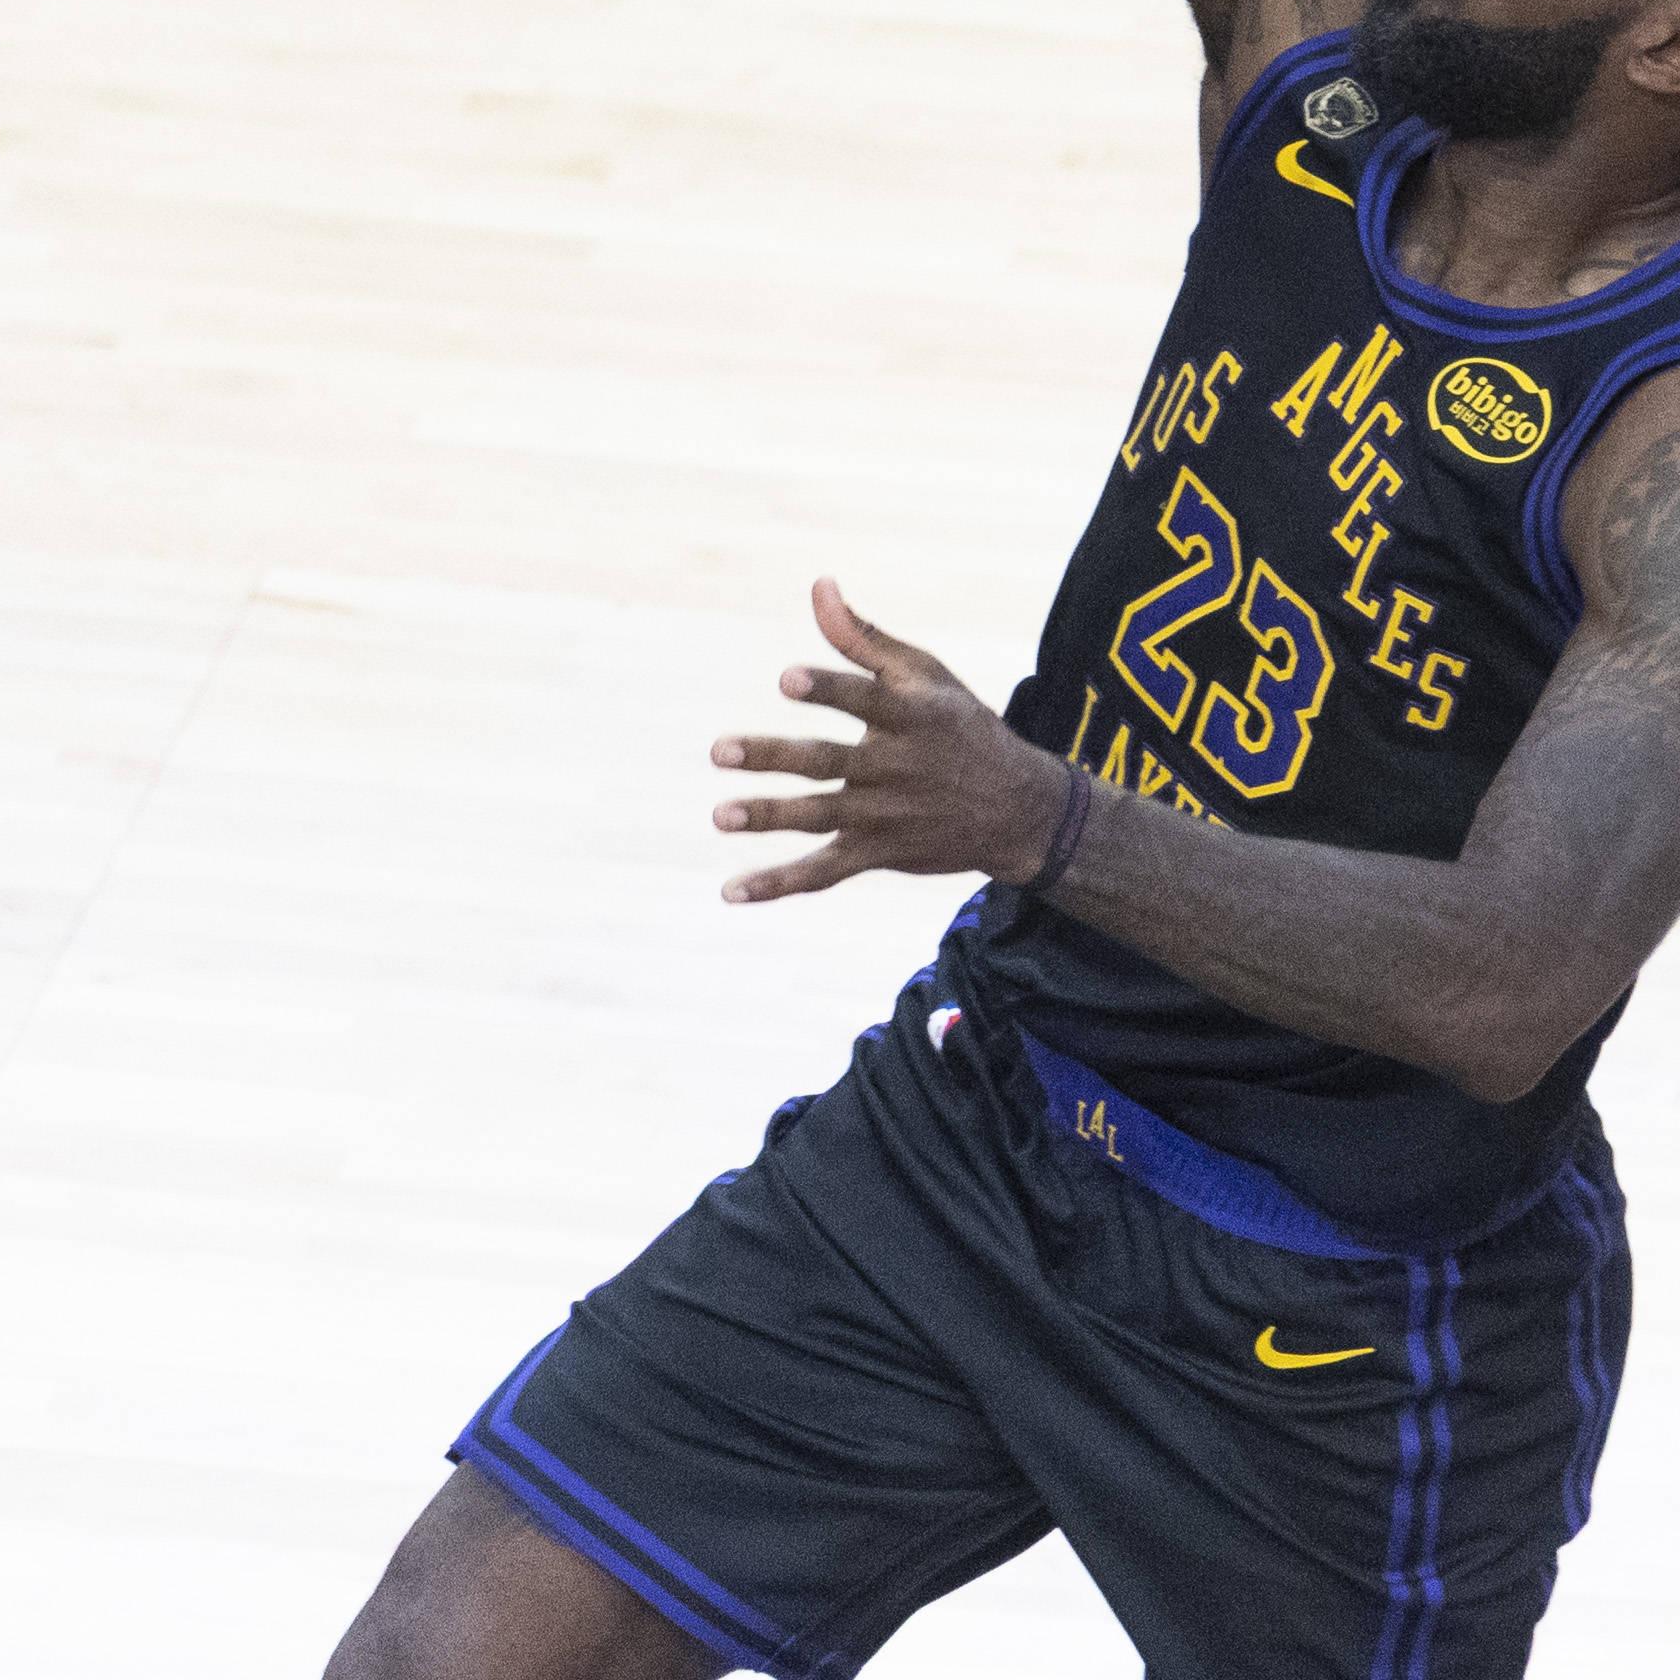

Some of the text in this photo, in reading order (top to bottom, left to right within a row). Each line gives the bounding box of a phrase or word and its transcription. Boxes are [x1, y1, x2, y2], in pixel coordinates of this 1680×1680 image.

[1445, 366, 1538, 444] bibigo
[1121, 323, 1466, 731] LOS ANGELES
[1108, 465, 1336, 799] 23
[1076, 1100, 1125, 1162] LAL
